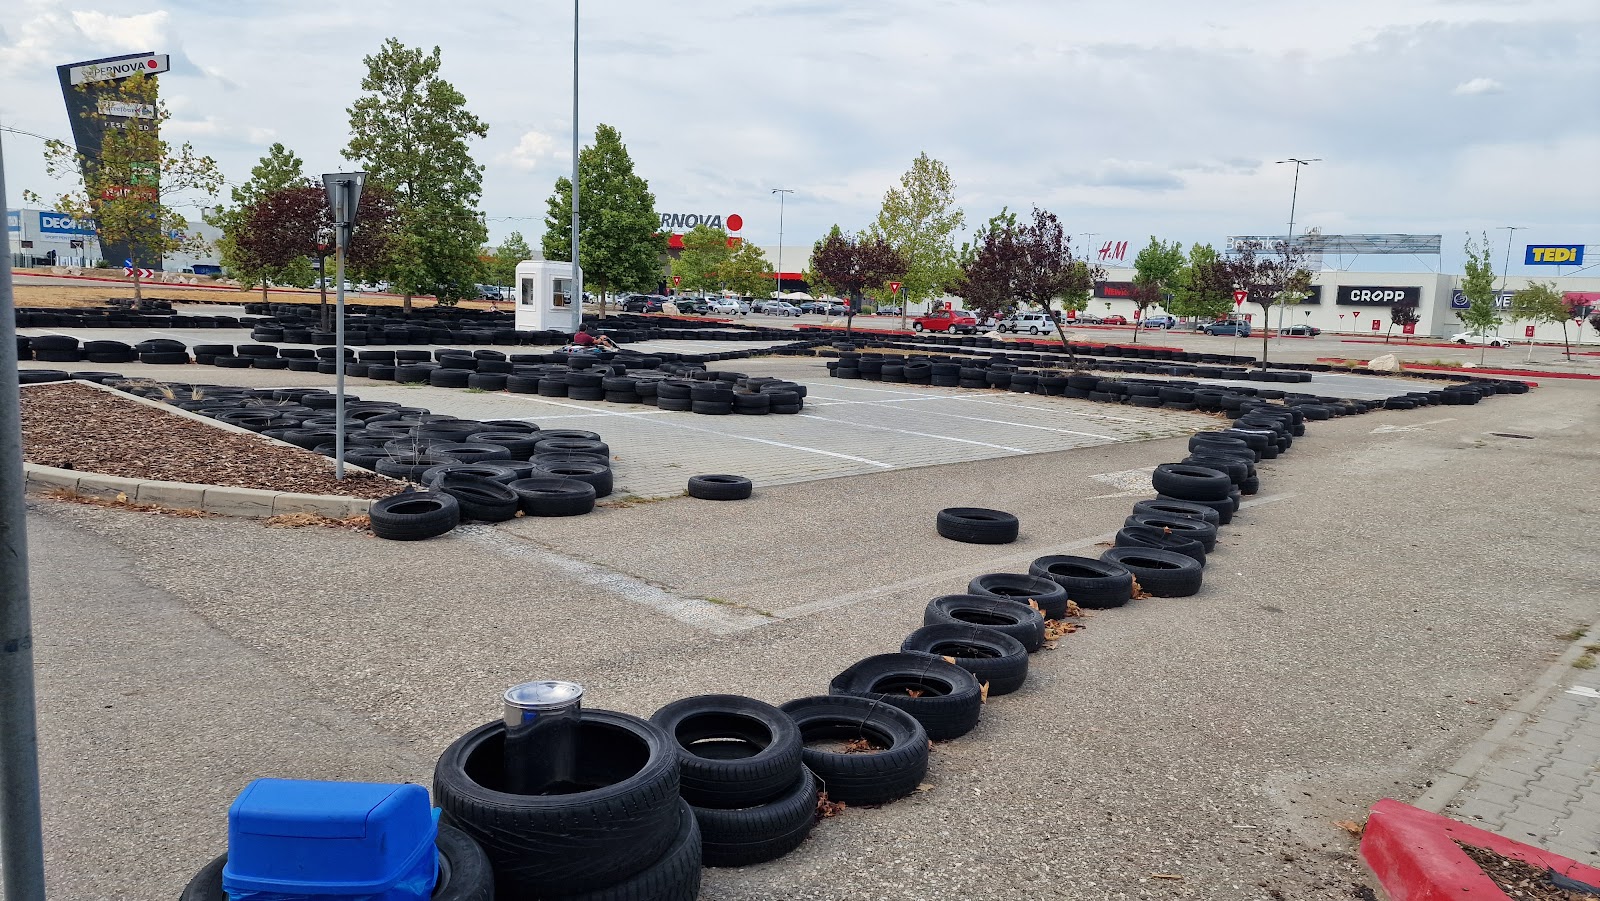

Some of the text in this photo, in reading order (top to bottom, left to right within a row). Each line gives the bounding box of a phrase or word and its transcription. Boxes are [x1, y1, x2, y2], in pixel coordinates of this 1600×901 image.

[81, 61, 146, 79] SPERNOVA
[1098, 240, 1128, 261] H&M
[1532, 247, 1577, 262] TEDi
[1350, 289, 1405, 302] CROPP
